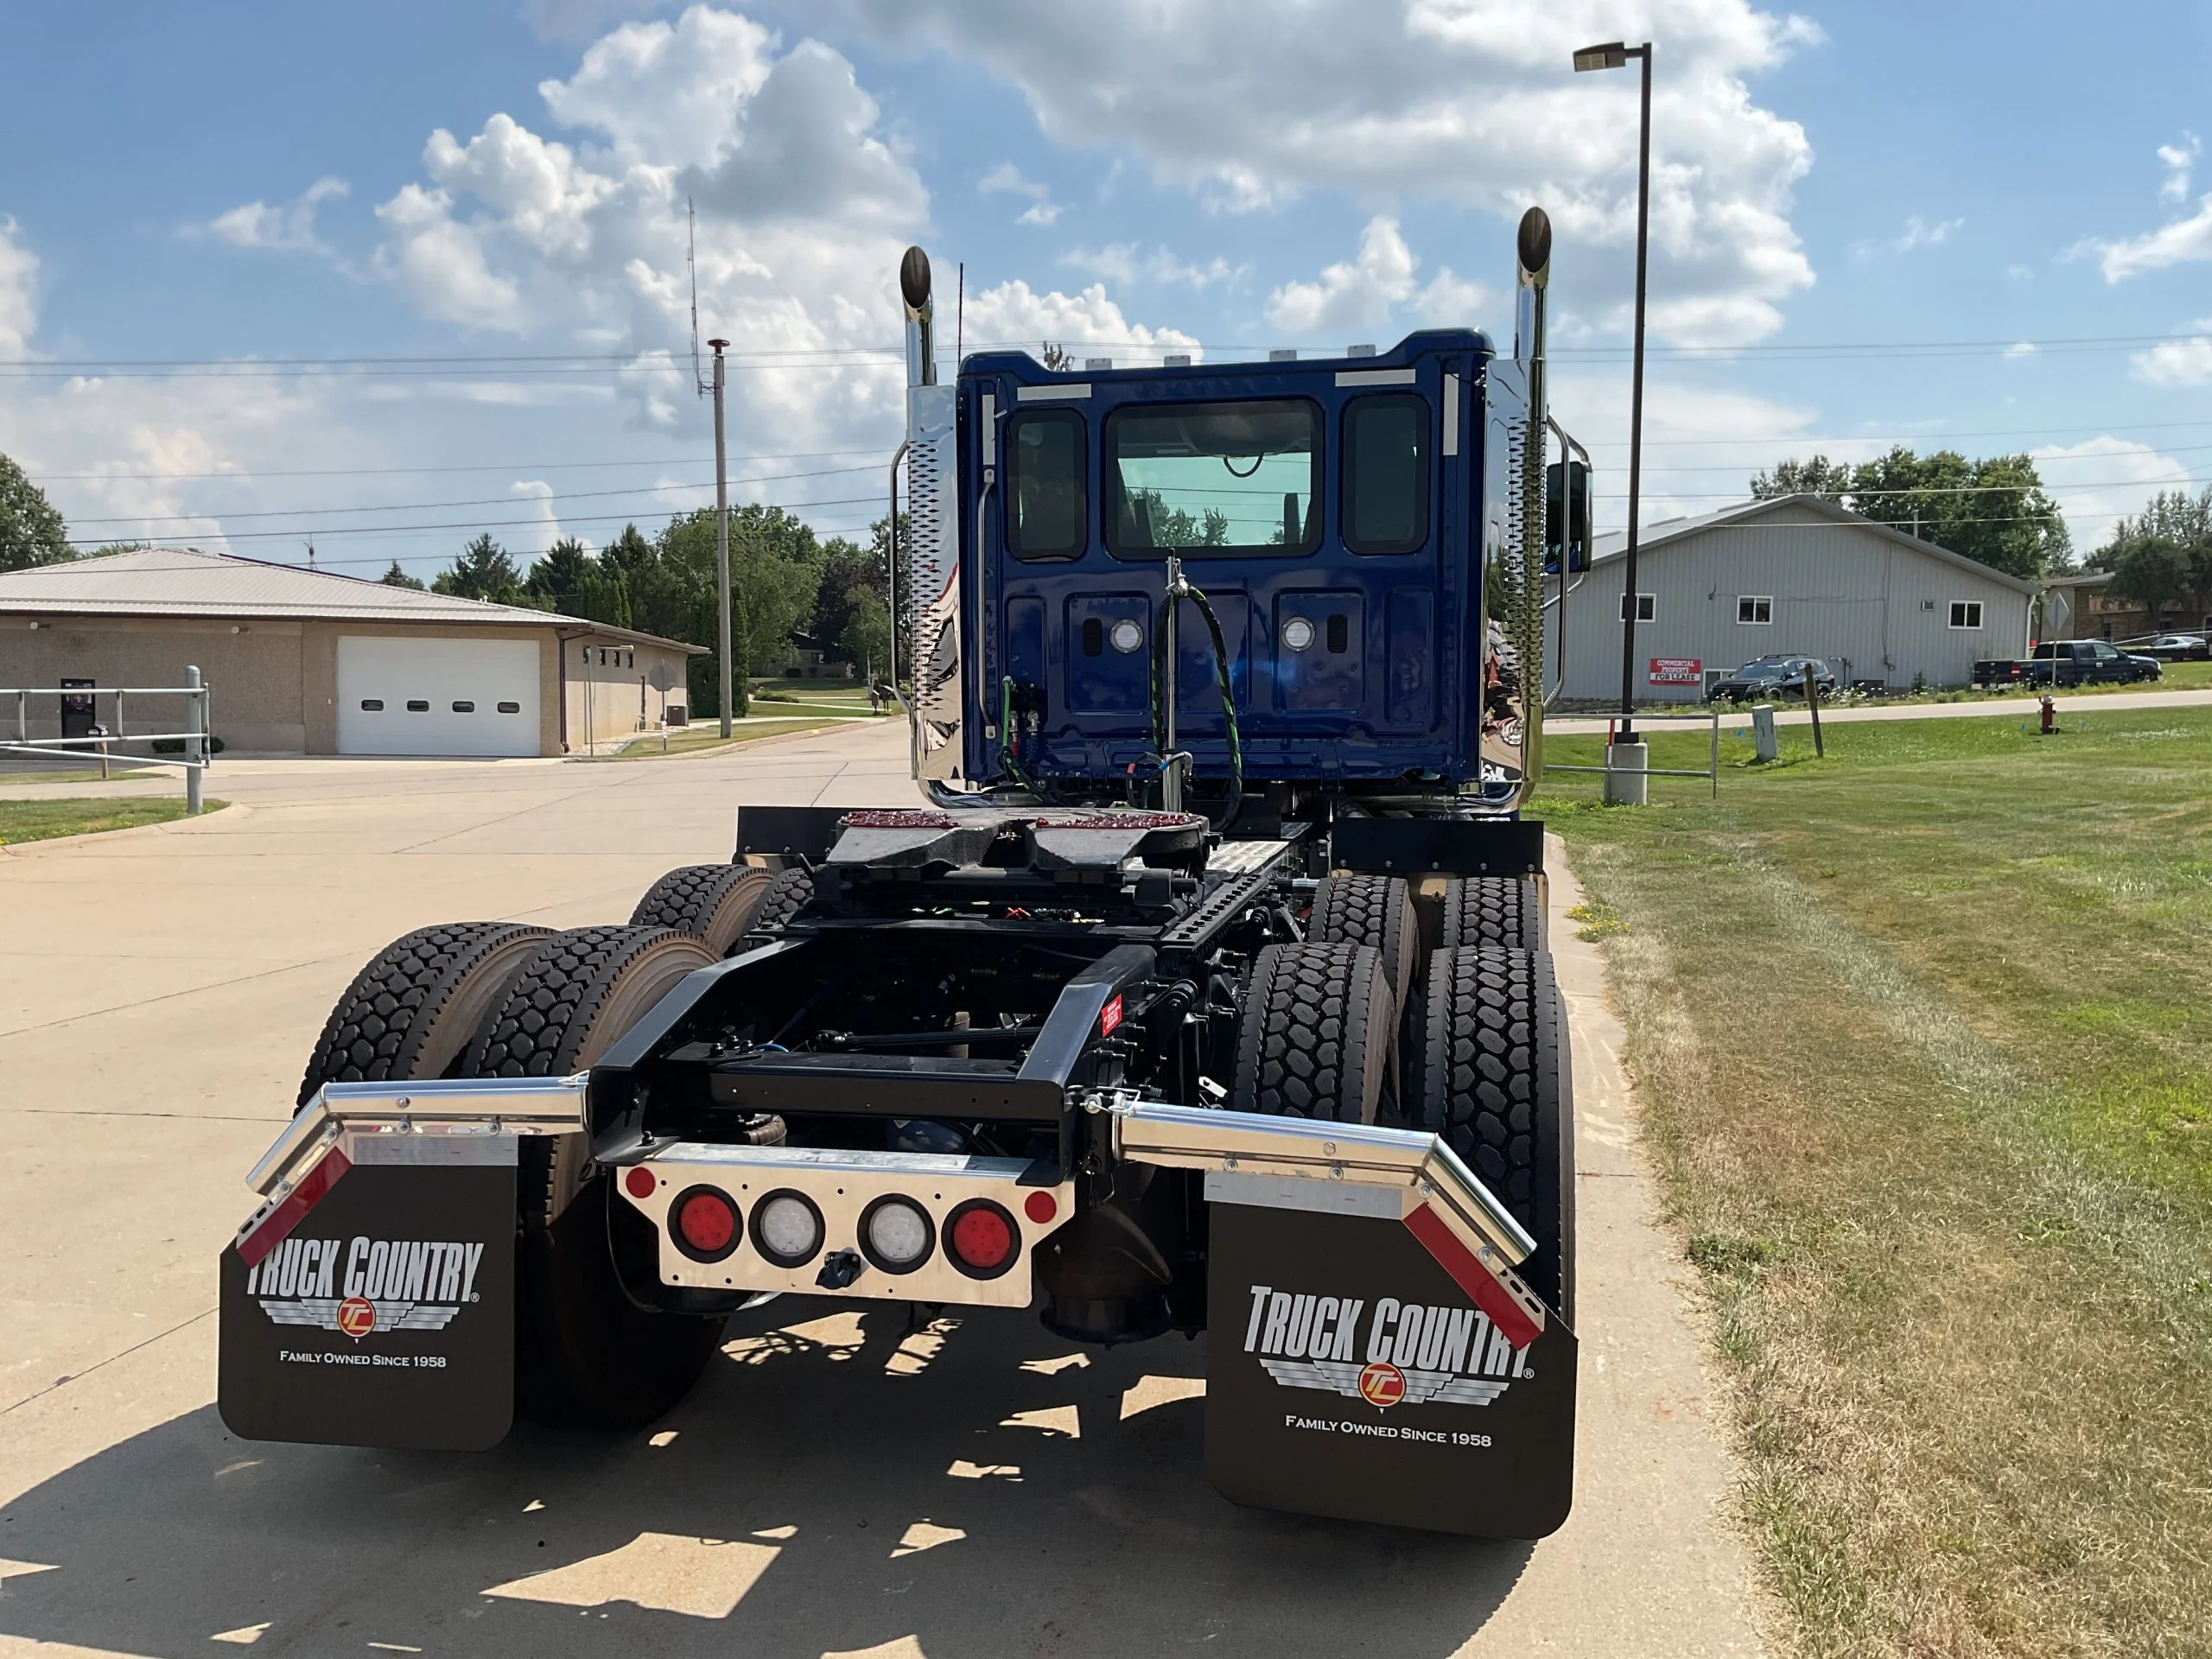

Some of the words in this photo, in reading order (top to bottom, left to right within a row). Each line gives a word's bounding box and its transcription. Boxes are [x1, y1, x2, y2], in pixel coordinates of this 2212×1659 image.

[1243, 1285, 1364, 1362] TRUCK
[279, 1350, 322, 1363] FAMILY
[323, 1352, 371, 1365] OWNED
[372, 1354, 410, 1367] SINCE
[413, 1356, 447, 1368] 1958
[1285, 1414, 1339, 1432] FAMILY
[1340, 1421, 1398, 1439] OWNED
[1400, 1427, 1447, 1444] SINCE
[1451, 1432, 1492, 1448] 1958
